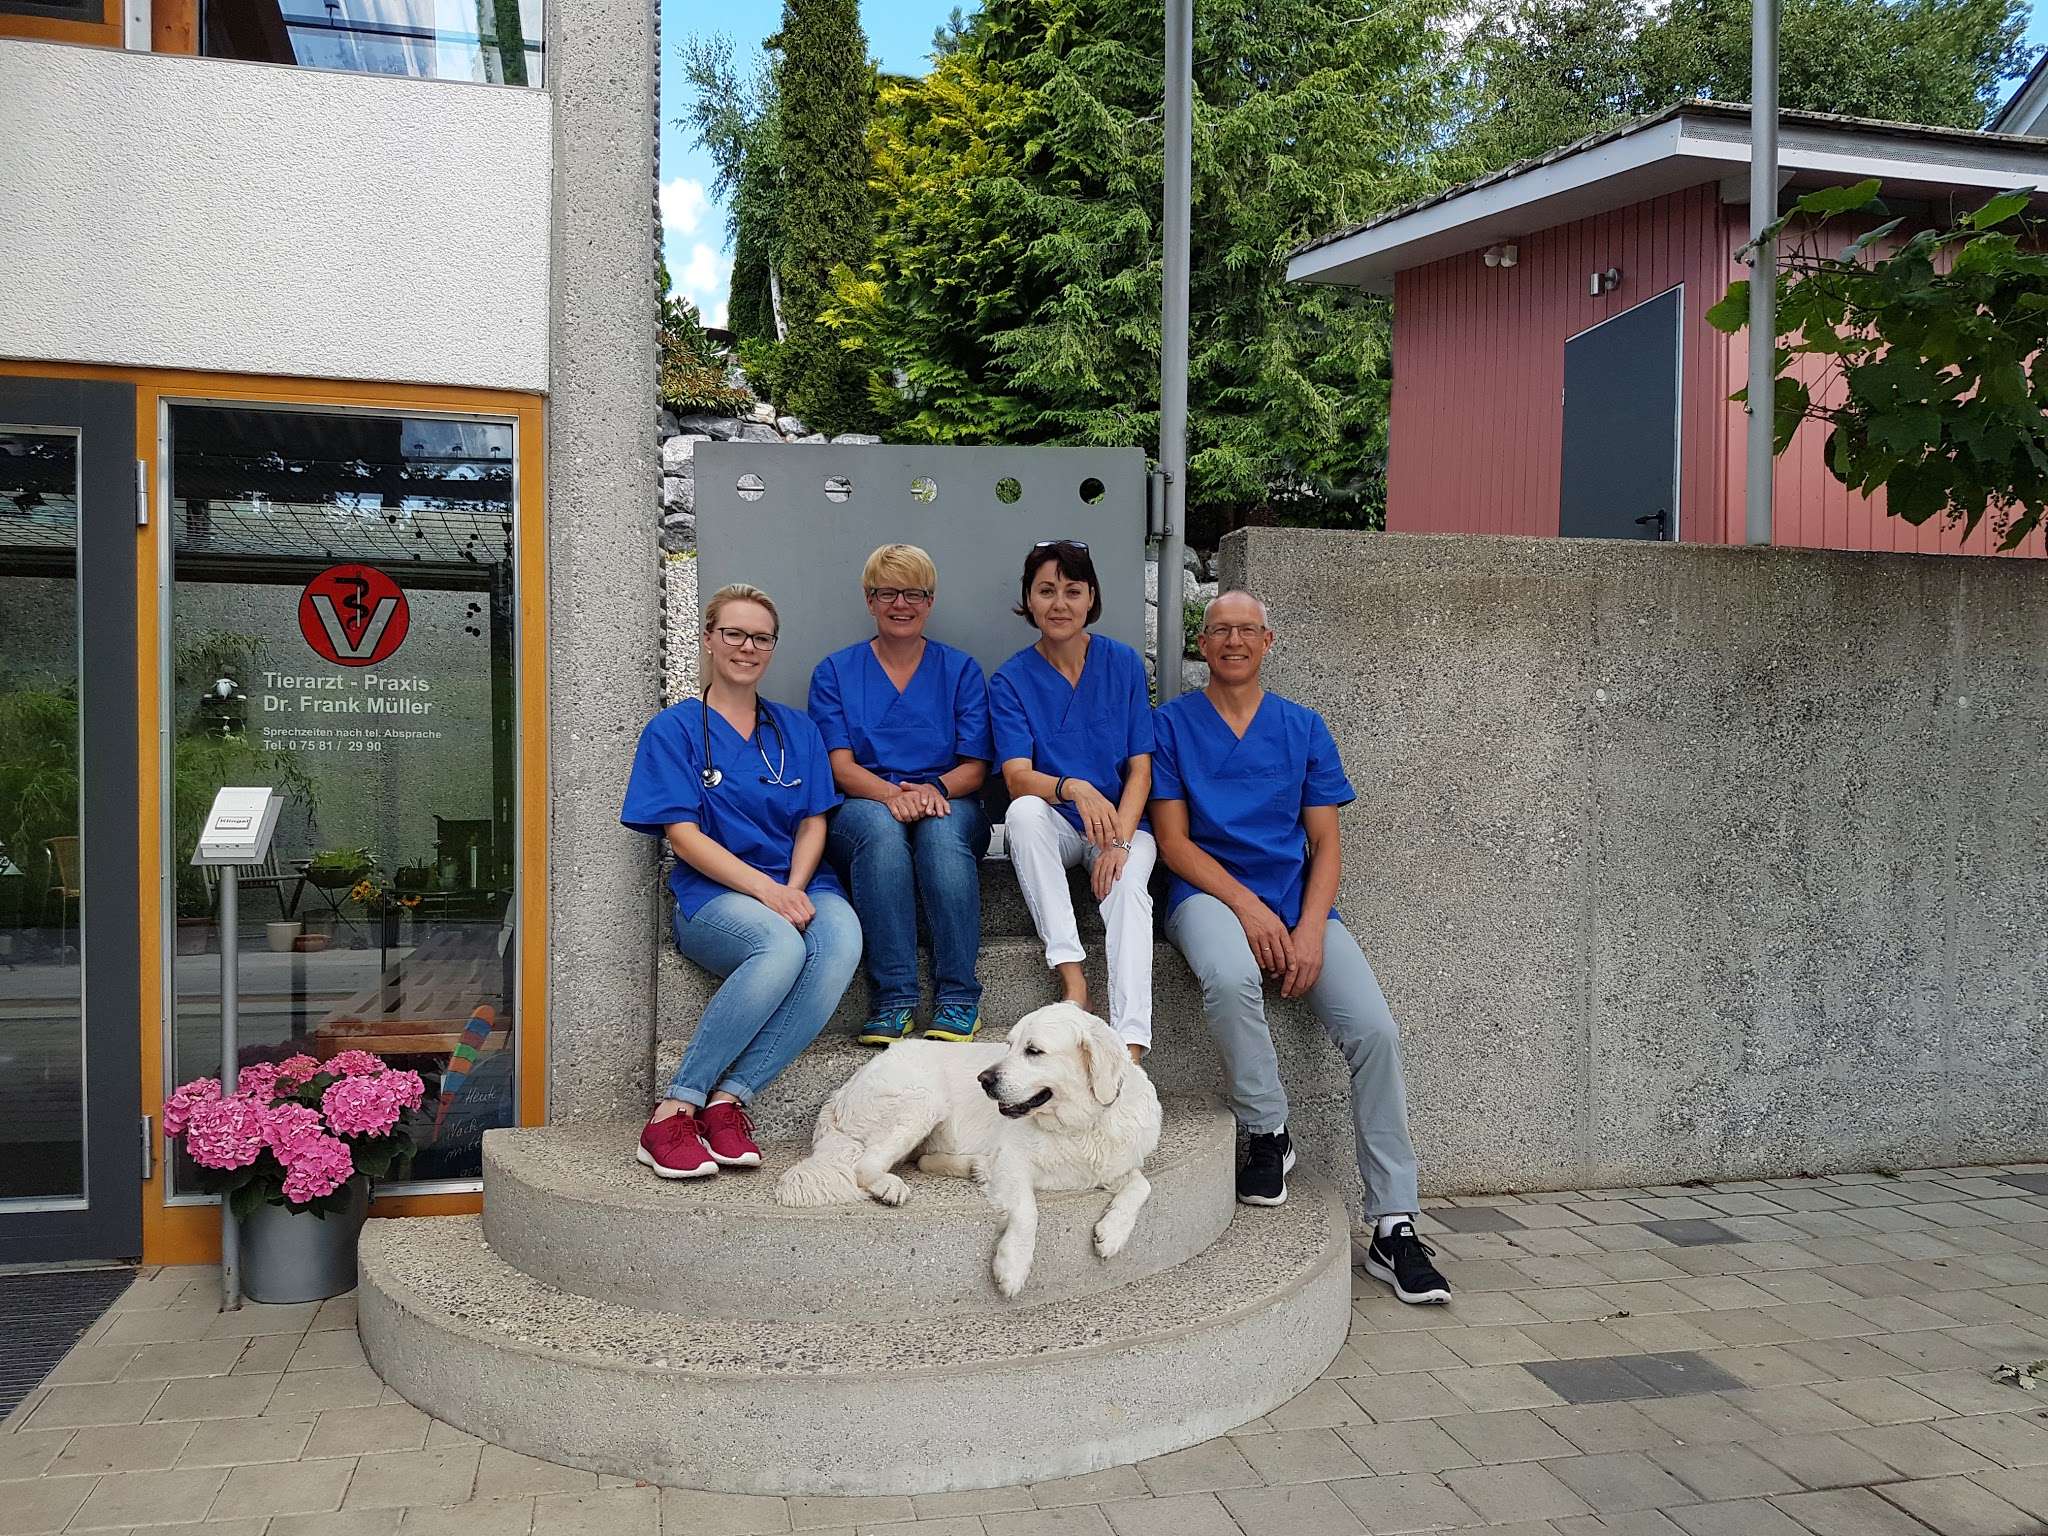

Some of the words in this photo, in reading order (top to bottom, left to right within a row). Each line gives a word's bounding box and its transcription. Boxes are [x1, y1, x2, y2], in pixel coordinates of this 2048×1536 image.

[263, 672, 344, 690] Tierarzt
[364, 675, 430, 692] Praxis
[263, 695, 292, 712] Dr.
[300, 696, 360, 713] Frank
[367, 697, 432, 715] Müller
[263, 727, 333, 739] Sprechzeiten
[336, 729, 364, 738] nach
[365, 729, 381, 738] tel.
[384, 729, 441, 740] Absprache
[263, 740, 286, 751] Tel.
[289, 741, 296, 751] 0
[301, 741, 315, 751] 75
[319, 741, 332, 751] 81
[348, 741, 363, 751] 29
[366, 742, 381, 752] 90
